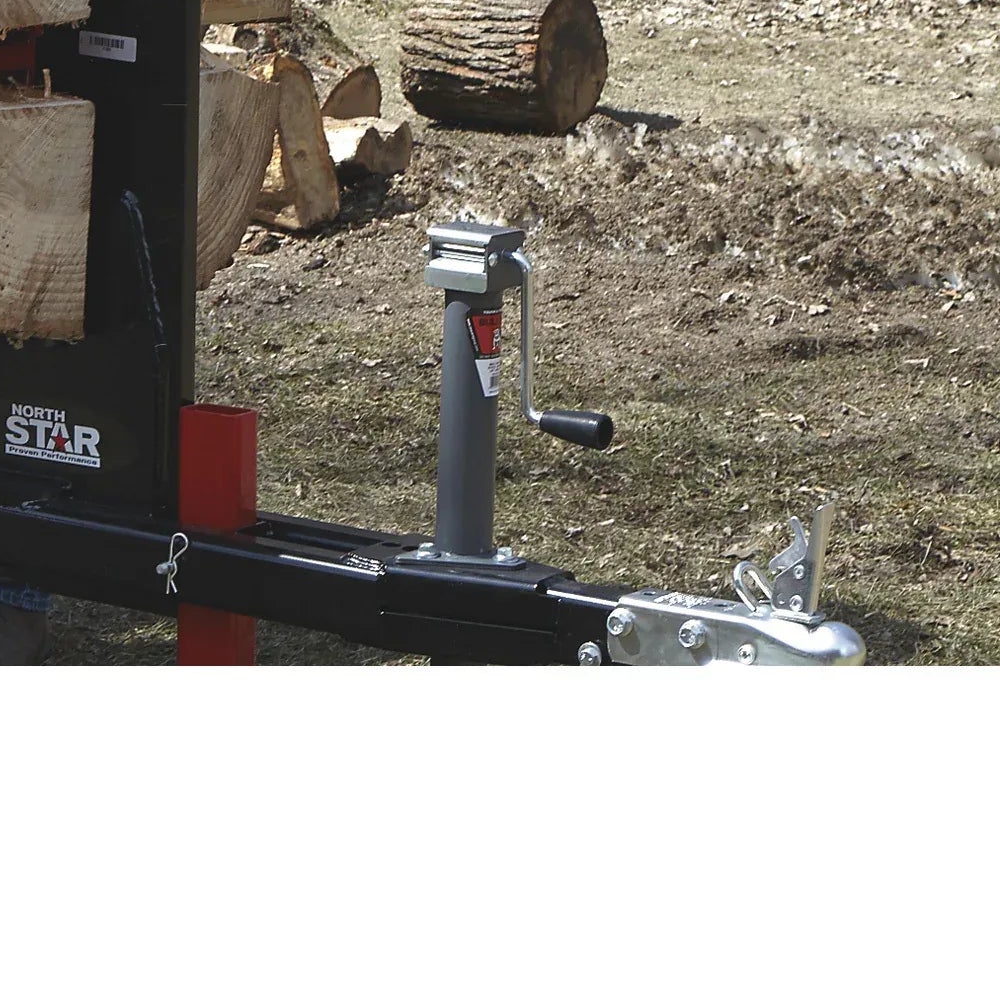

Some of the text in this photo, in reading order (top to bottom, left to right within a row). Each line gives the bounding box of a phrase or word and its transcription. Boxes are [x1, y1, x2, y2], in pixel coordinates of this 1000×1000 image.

[11, 403, 66, 422] NORTH
[5, 415, 100, 457] STAR
[9, 446, 98, 466] Proven Performance
